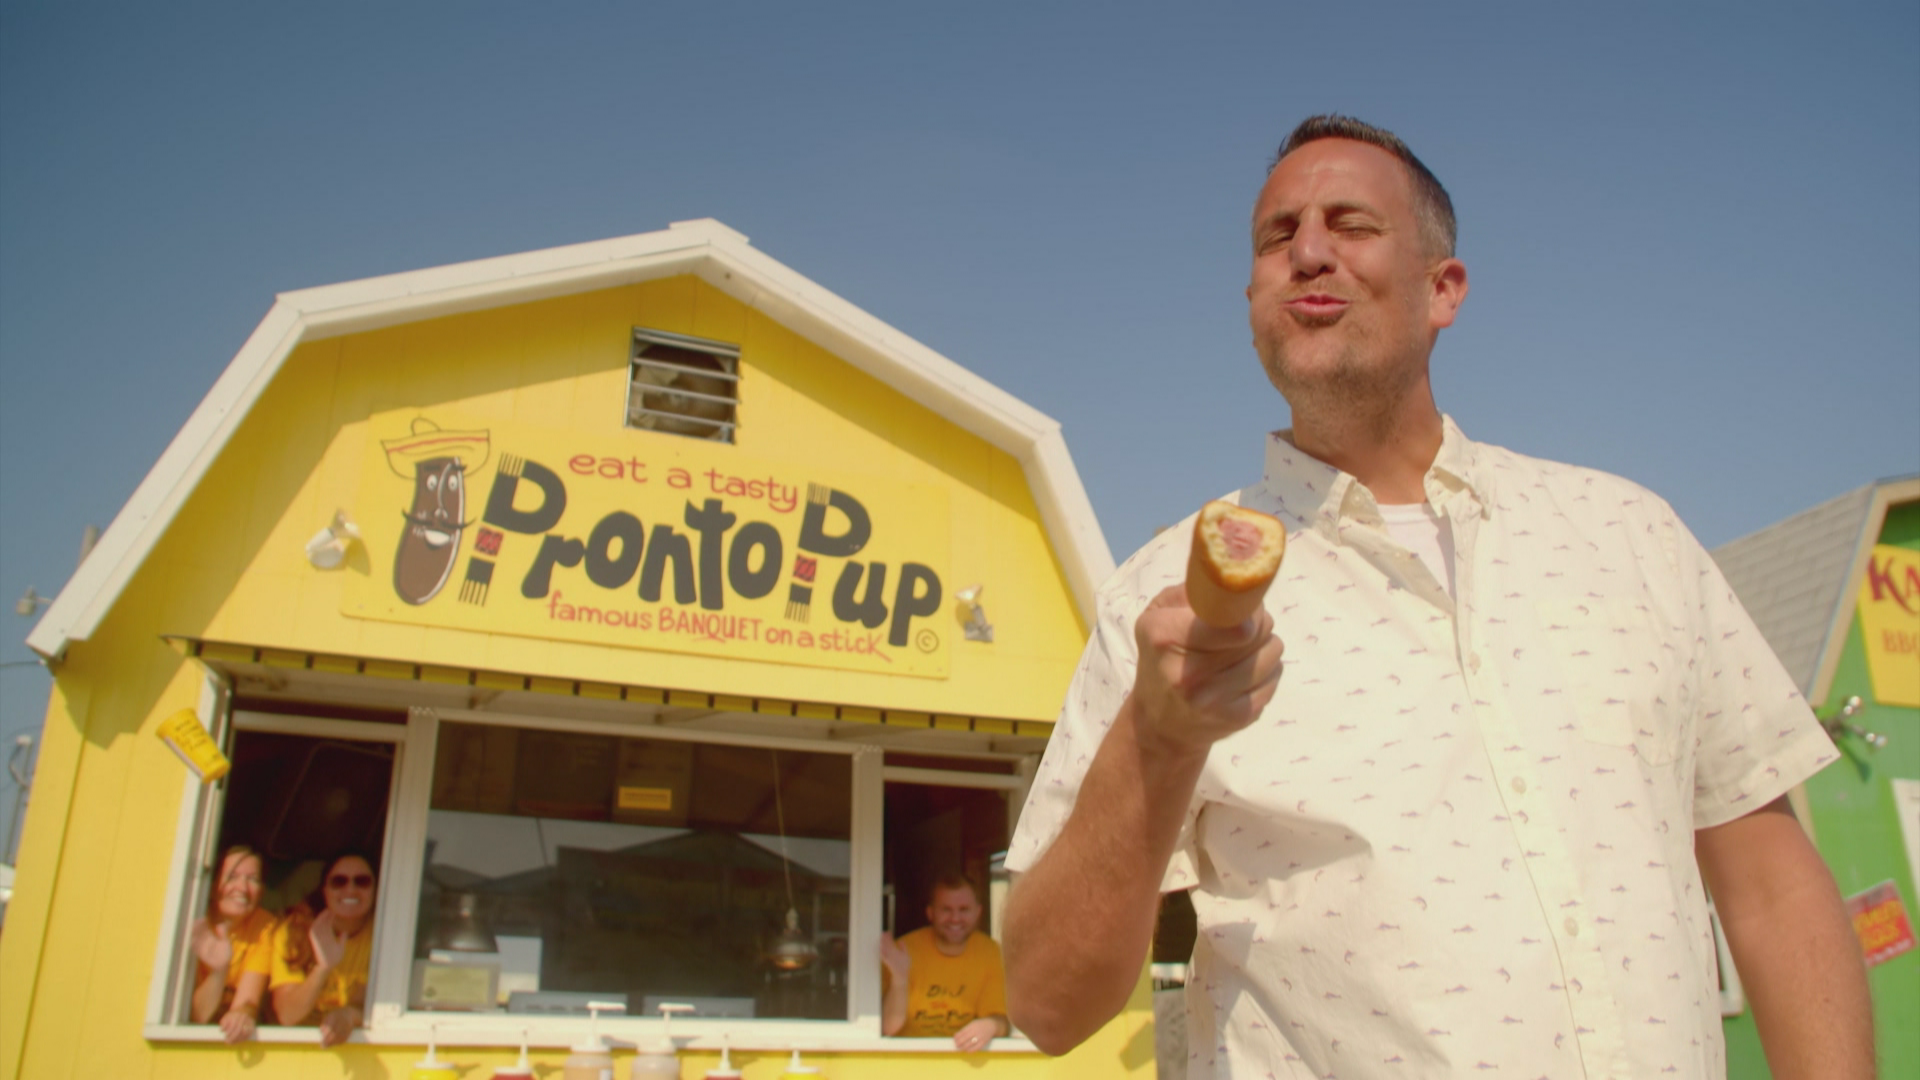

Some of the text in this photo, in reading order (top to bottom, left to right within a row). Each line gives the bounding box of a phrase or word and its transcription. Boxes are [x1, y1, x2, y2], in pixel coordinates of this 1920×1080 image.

[569, 454, 798, 514] eat a tasty
[458, 452, 942, 647] Pronto Pup
[546, 590, 653, 630] famous
[658, 606, 763, 643] BANQUET
[765, 627, 793, 645] on
[797, 630, 815, 648] a
